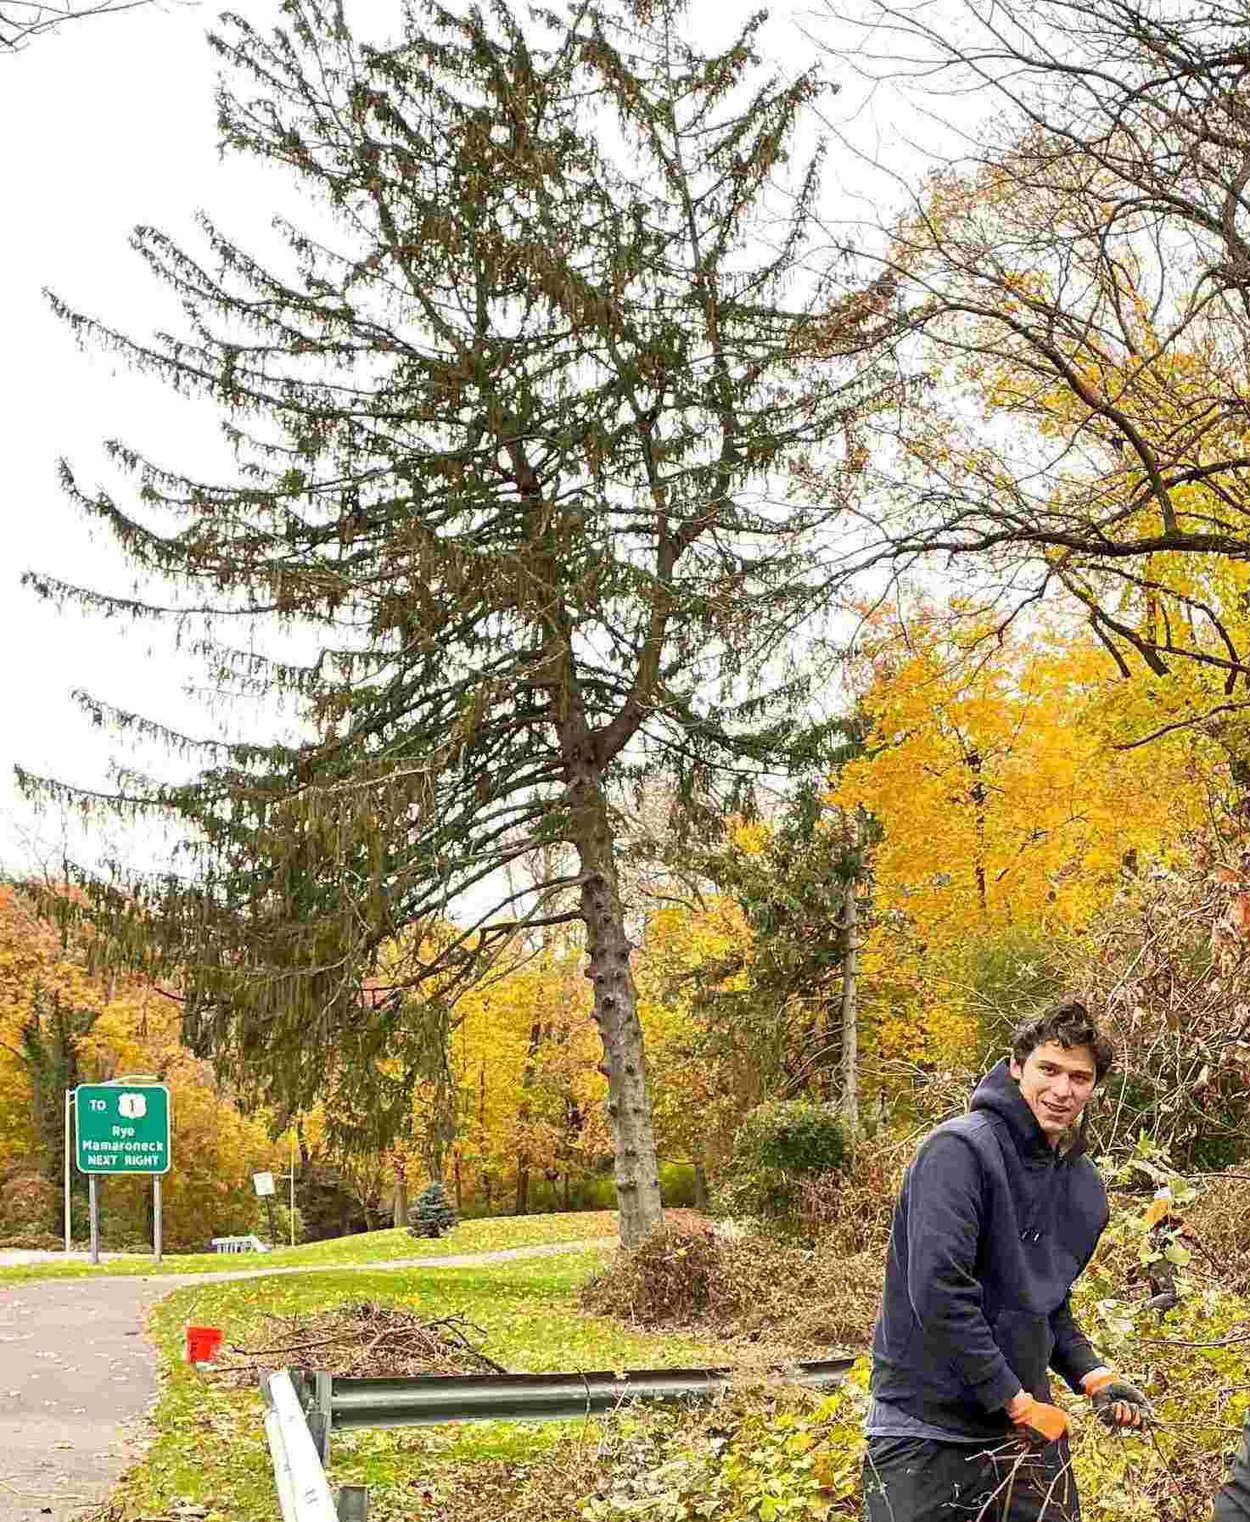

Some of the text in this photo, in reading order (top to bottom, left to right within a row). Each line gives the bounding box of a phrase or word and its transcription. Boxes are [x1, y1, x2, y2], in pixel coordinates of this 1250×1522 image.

[90, 1099, 135, 1112] TO 1
[112, 1126, 135, 1139] Rye
[82, 1141, 163, 1152] Mamaroneck
[87, 1155, 159, 1166] NEXT RIGHT
